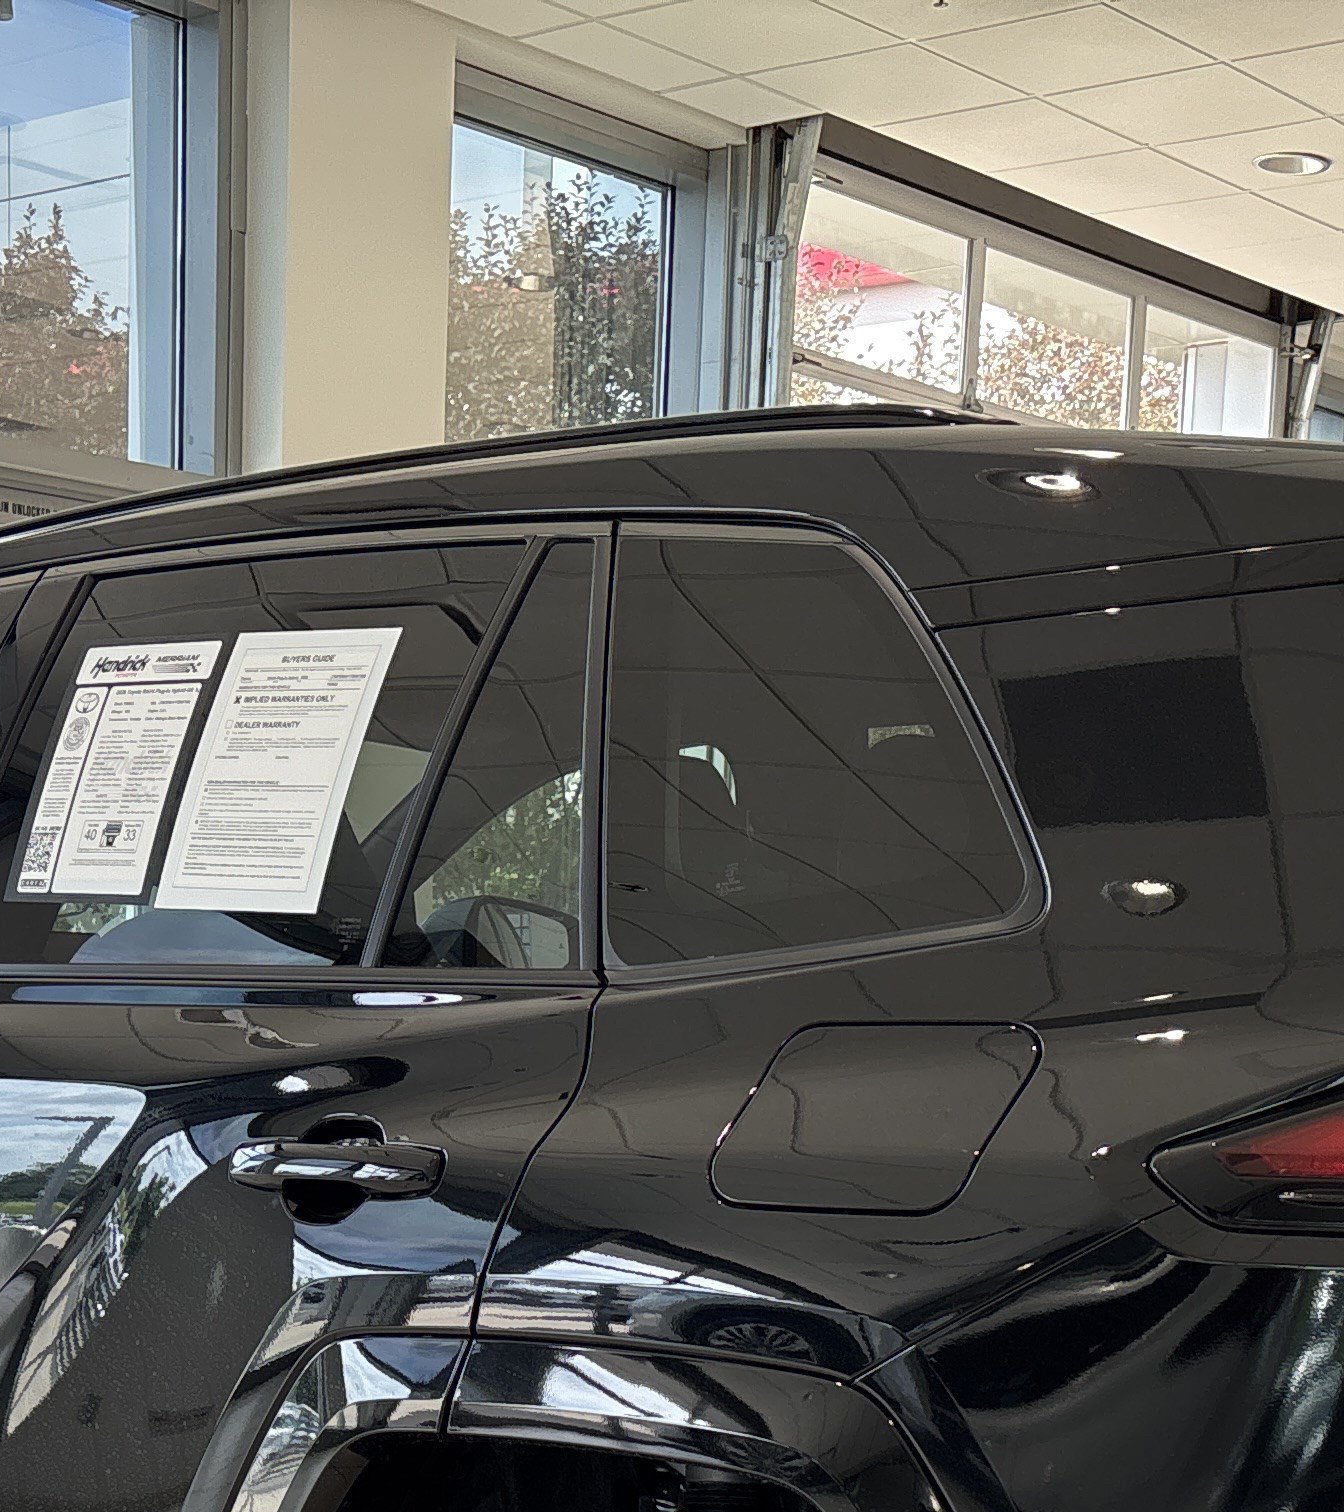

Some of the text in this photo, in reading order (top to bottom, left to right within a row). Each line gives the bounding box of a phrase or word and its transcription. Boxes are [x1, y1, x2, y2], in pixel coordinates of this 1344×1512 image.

[281, 654, 336, 663] BUYERS GUIDE
[90, 654, 150, 679] Hendrick
[271, 695, 315, 703] WARRANTIES
[84, 829, 97, 841] 40
[123, 829, 137, 841] 33
